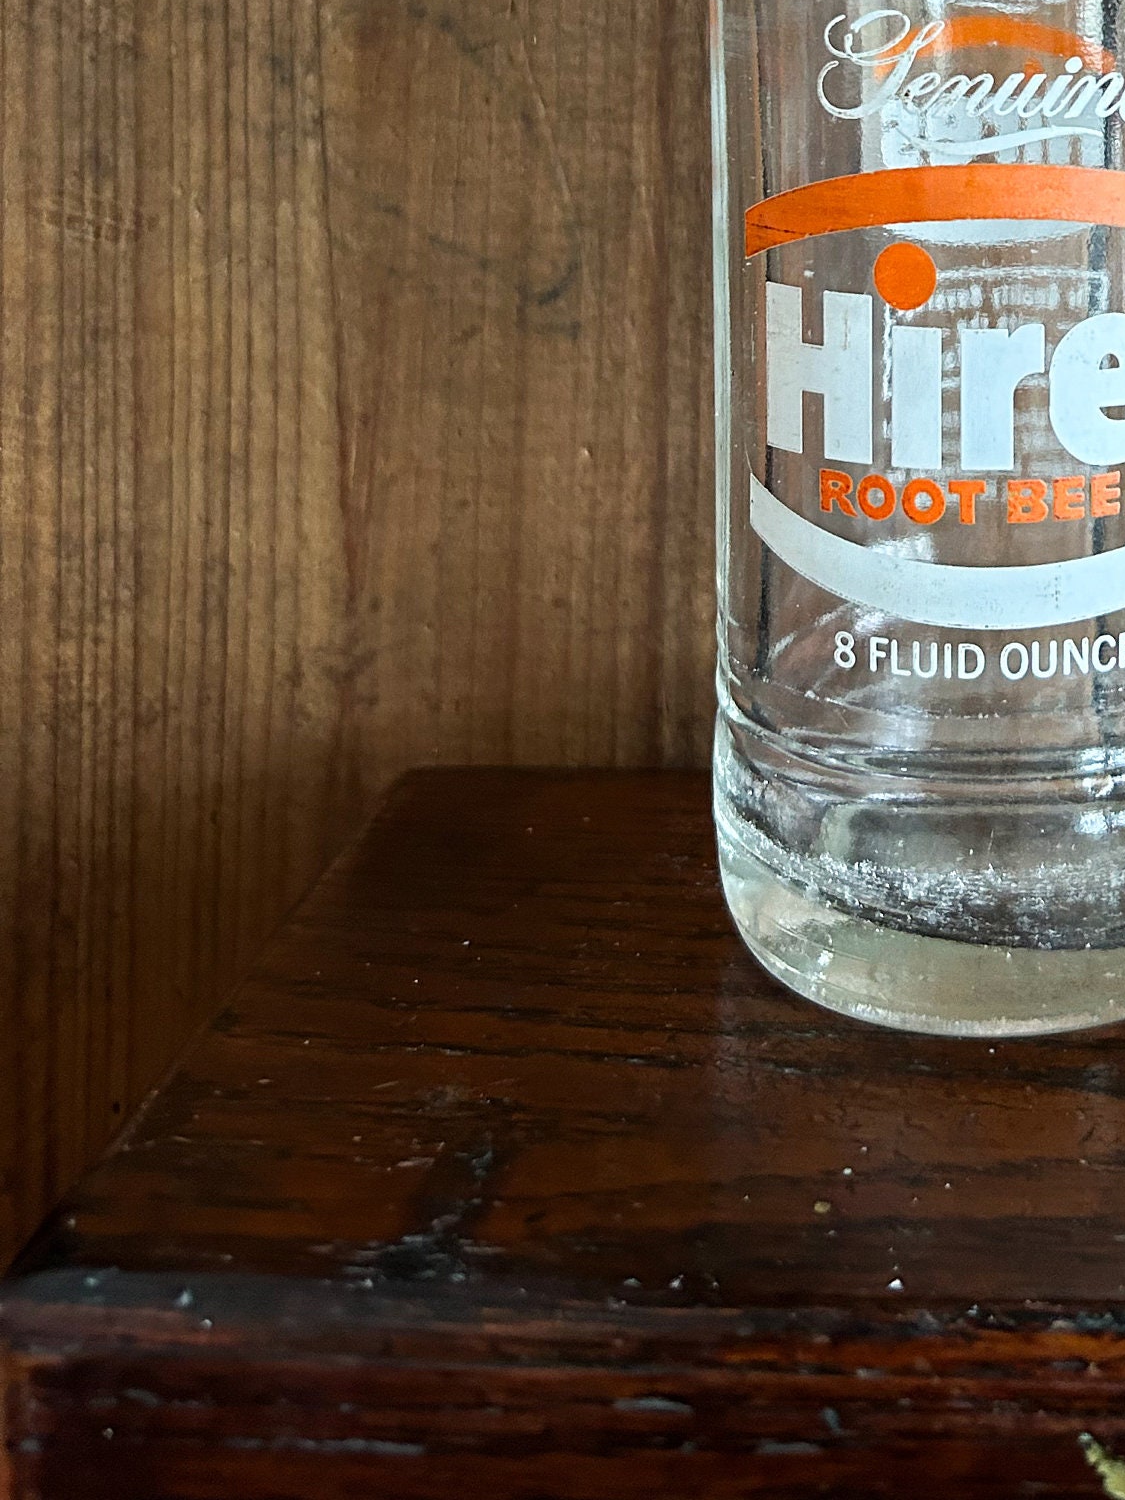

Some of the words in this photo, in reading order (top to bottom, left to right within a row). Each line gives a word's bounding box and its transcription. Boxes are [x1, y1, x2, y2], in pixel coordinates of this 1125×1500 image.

[819, 467, 987, 526] ROOT
[834, 630, 857, 671] 8
[869, 636, 987, 681] FLUID
